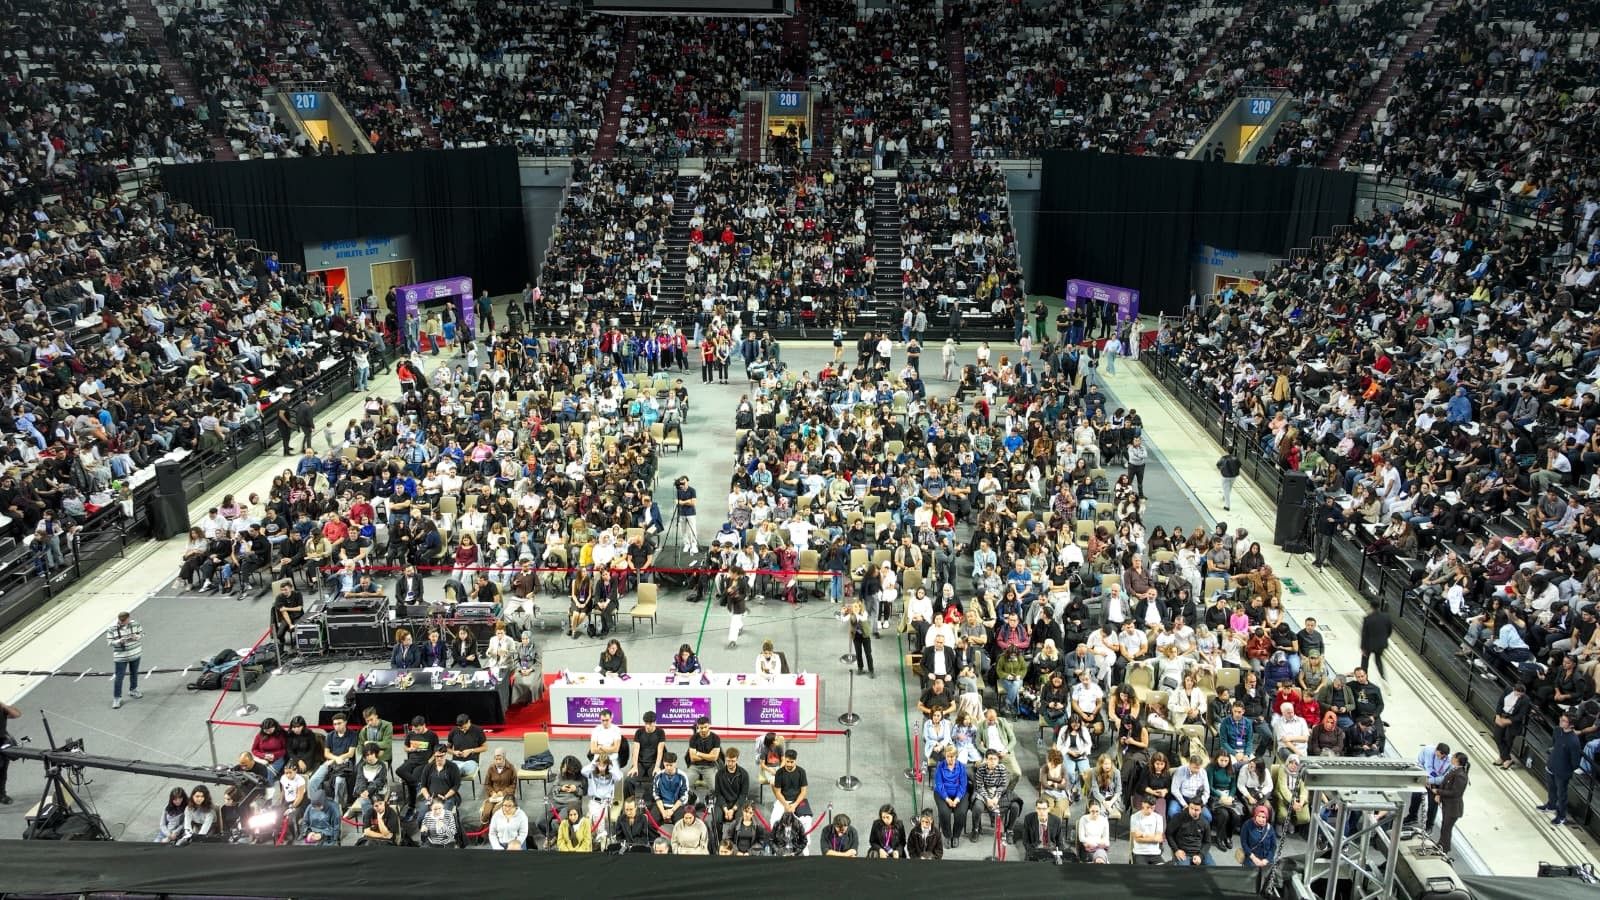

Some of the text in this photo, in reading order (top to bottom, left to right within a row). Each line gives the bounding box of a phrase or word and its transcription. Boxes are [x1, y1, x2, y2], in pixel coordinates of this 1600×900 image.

[296, 94, 315, 109] 207
[780, 93, 797, 106] 208
[1252, 100, 1271, 114] 209
